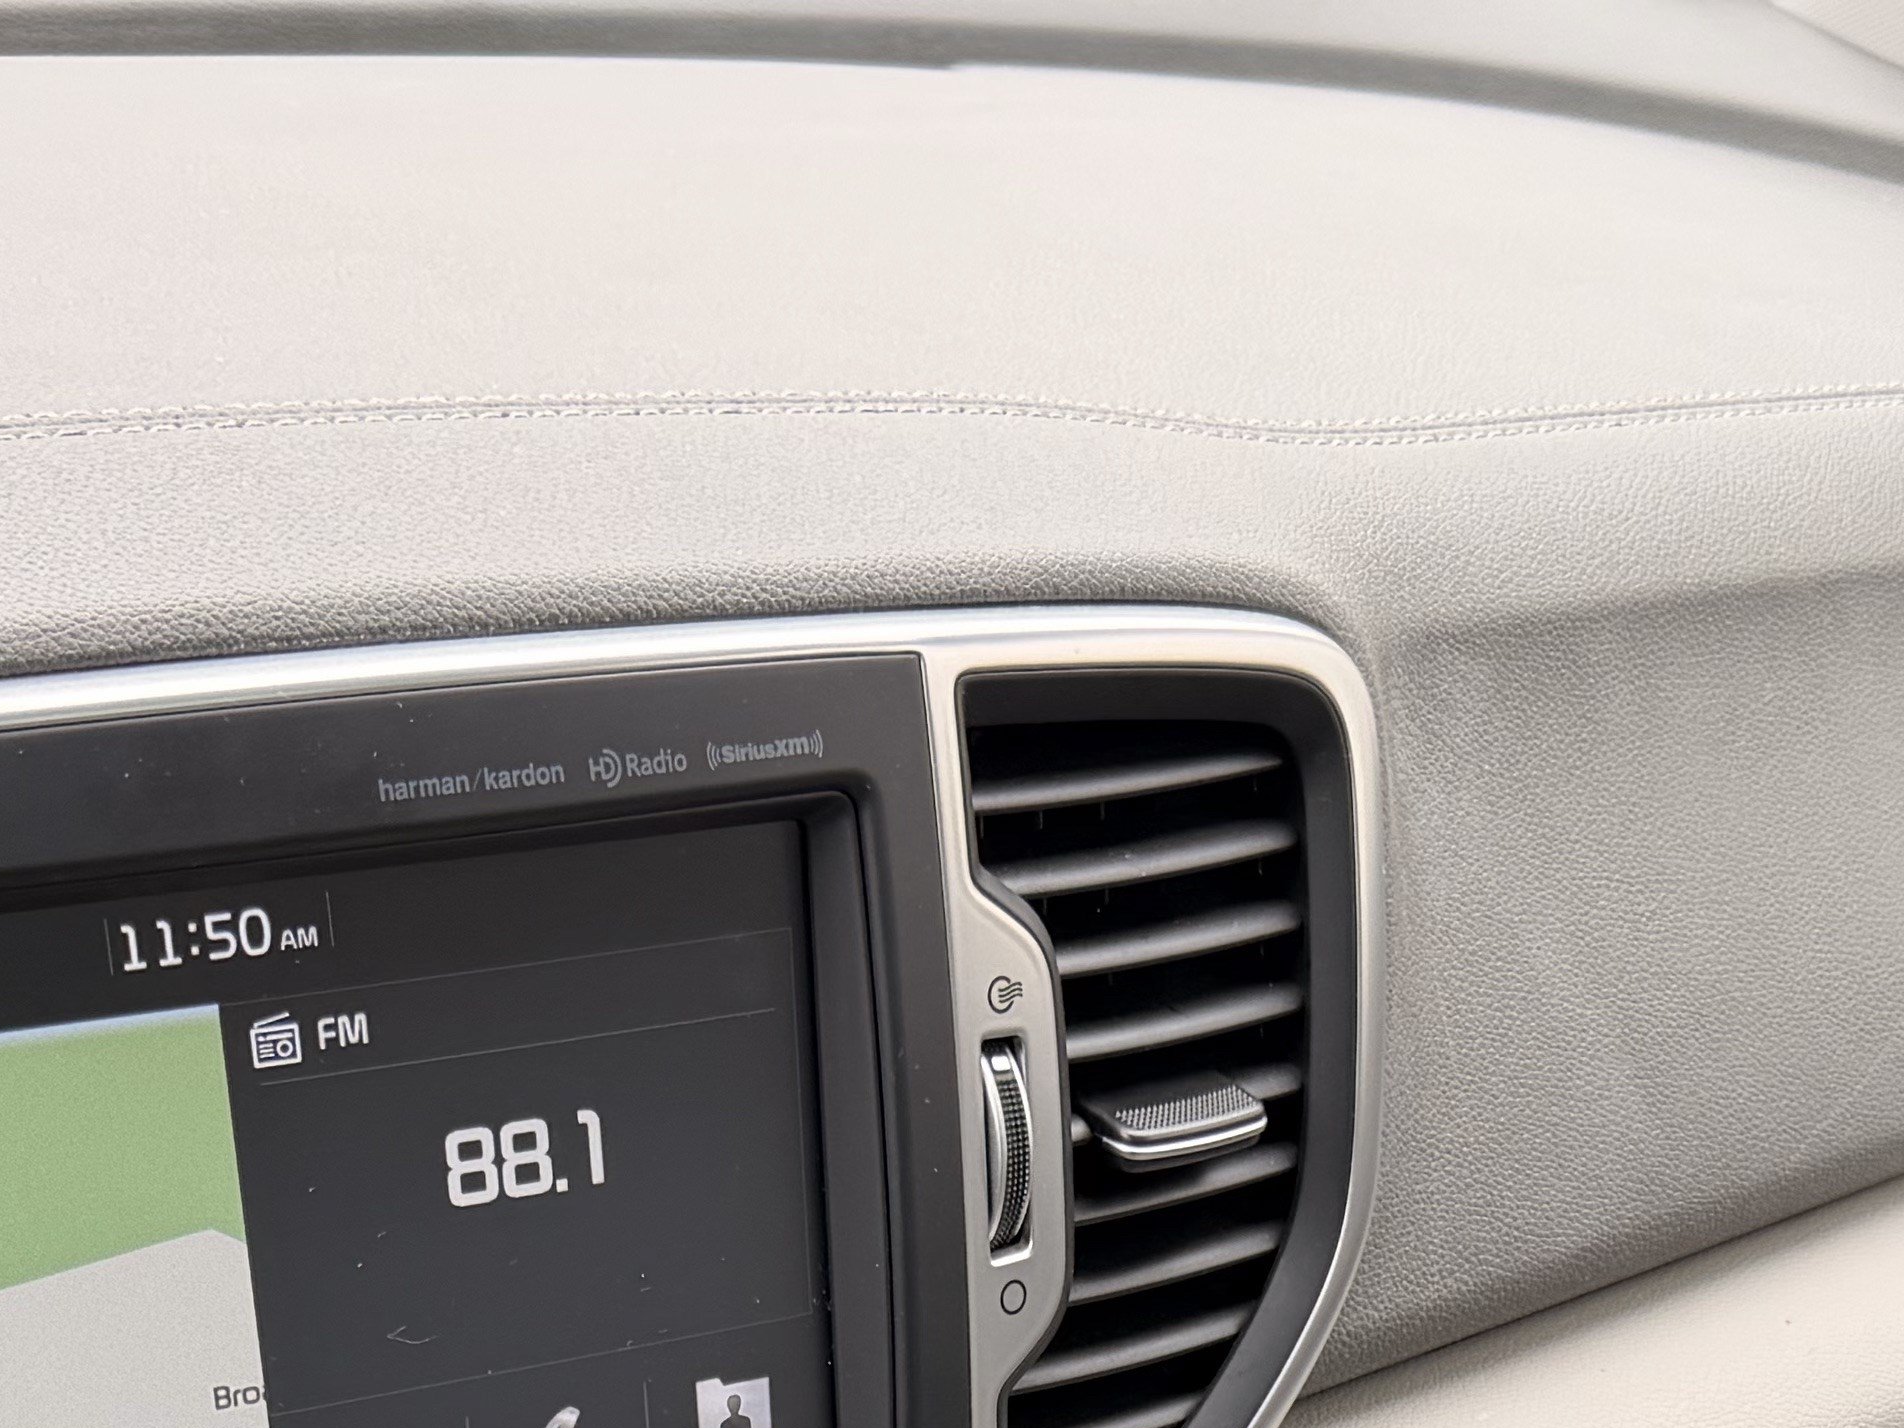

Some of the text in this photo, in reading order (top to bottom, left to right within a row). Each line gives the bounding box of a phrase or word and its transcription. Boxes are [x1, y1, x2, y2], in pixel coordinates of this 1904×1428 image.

[379, 762, 566, 802] harman/kardon
[626, 748, 688, 779] Radio
[121, 907, 319, 972] 11:50 AM
[317, 1011, 370, 1051] FM
[444, 1109, 606, 1208] 88.1
[213, 1384, 268, 1411] Bro
